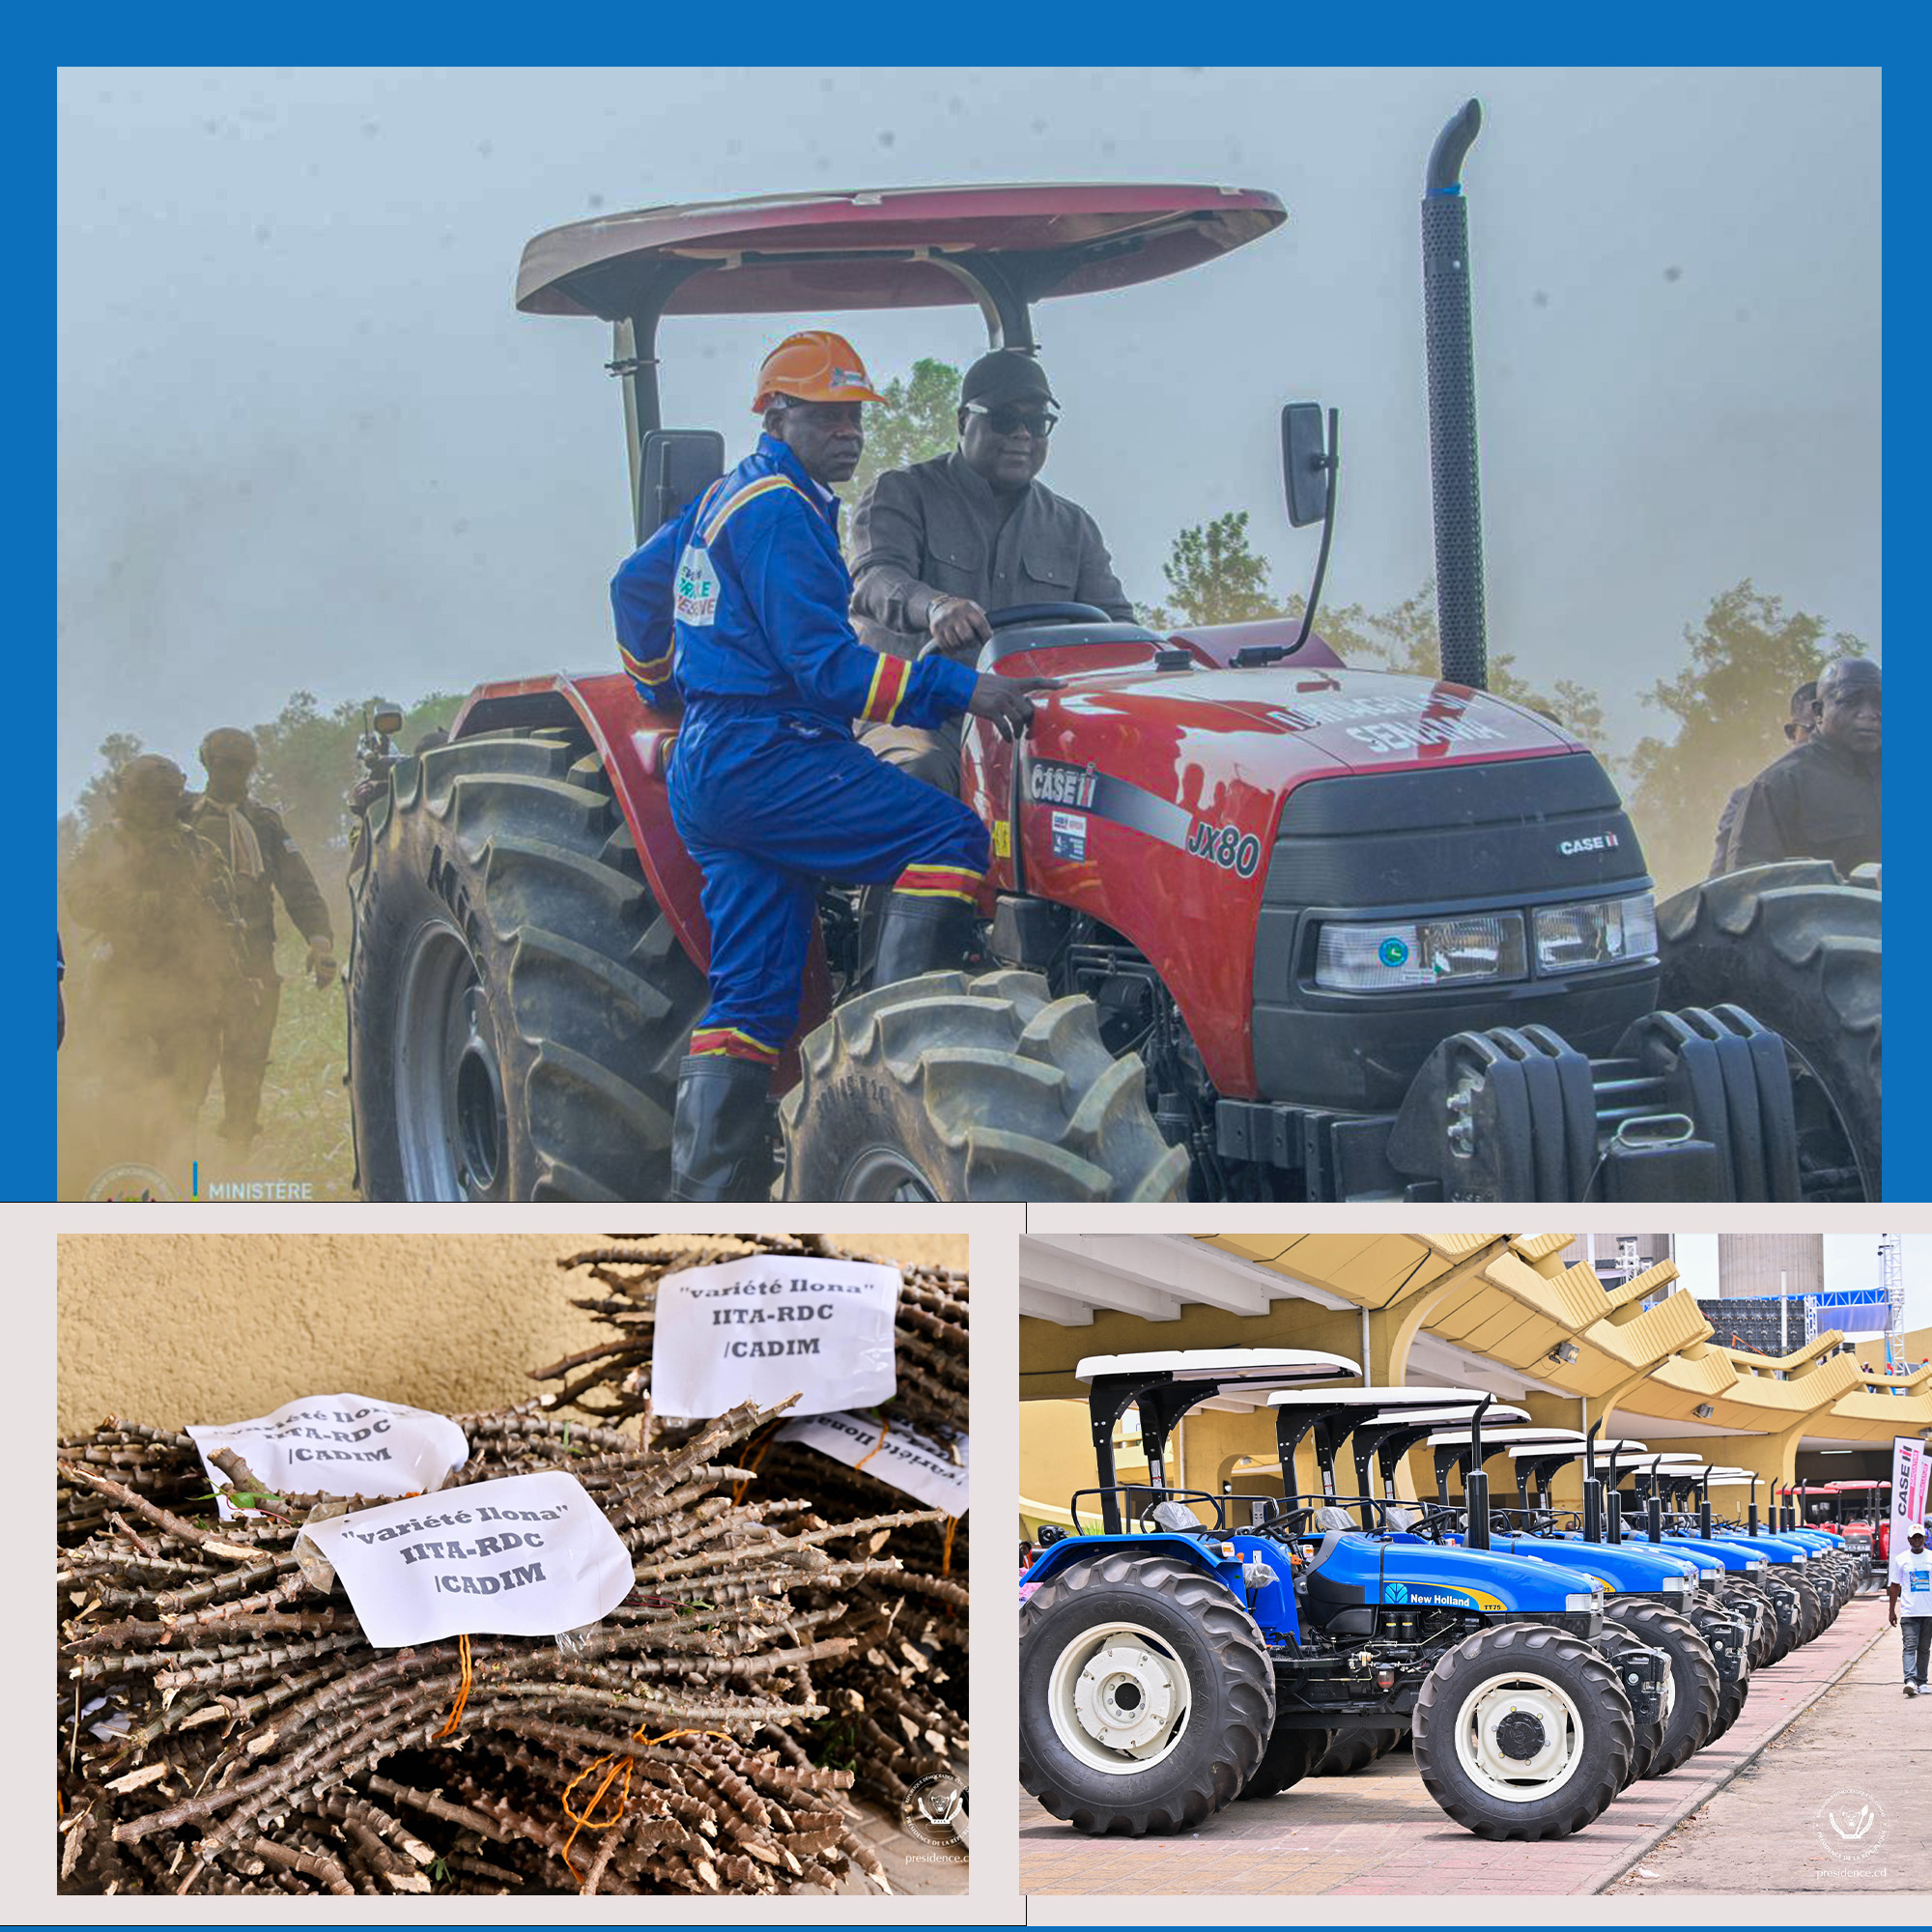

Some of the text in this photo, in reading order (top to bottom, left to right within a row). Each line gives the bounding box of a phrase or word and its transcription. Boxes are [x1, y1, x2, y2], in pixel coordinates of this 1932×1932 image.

[1031, 764, 1077, 804] CASE
[1188, 821, 1261, 878] JX80
[1560, 837, 1605, 855] CASE
[680, 1279, 782, 1298] "variété
[712, 1304, 834, 1325] IITA-RDC
[724, 1337, 821, 1358] /CADIM
[1898, 1463, 1911, 1516] CASE
[341, 1504, 569, 1545] "variété Ilona"
[399, 1532, 545, 1565] IITA-RDC
[1410, 1594, 1470, 1606] New Holland
